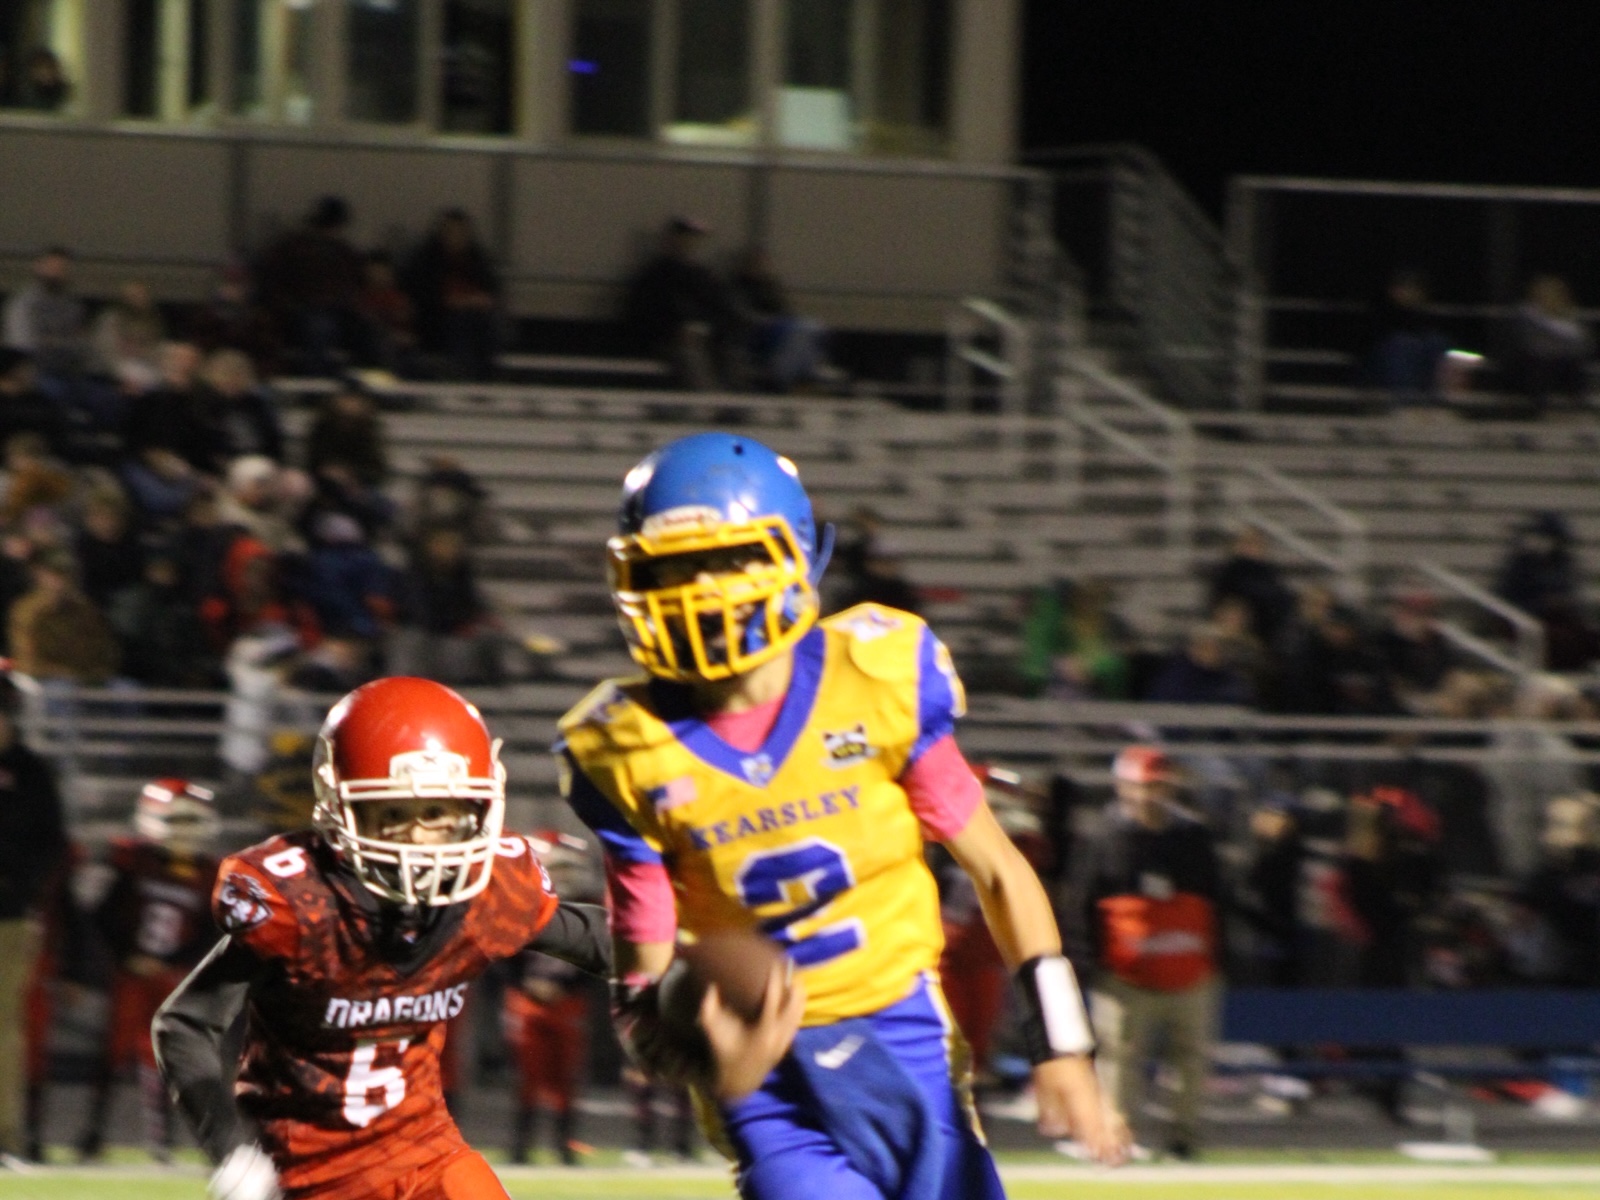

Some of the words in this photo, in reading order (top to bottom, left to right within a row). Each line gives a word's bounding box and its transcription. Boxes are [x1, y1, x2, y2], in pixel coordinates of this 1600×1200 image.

[690, 786, 861, 850] KEARSLEY
[263, 846, 307, 878] 6
[735, 837, 865, 967] 2
[325, 984, 467, 1028] DRAGONS
[343, 1038, 410, 1128] 6
